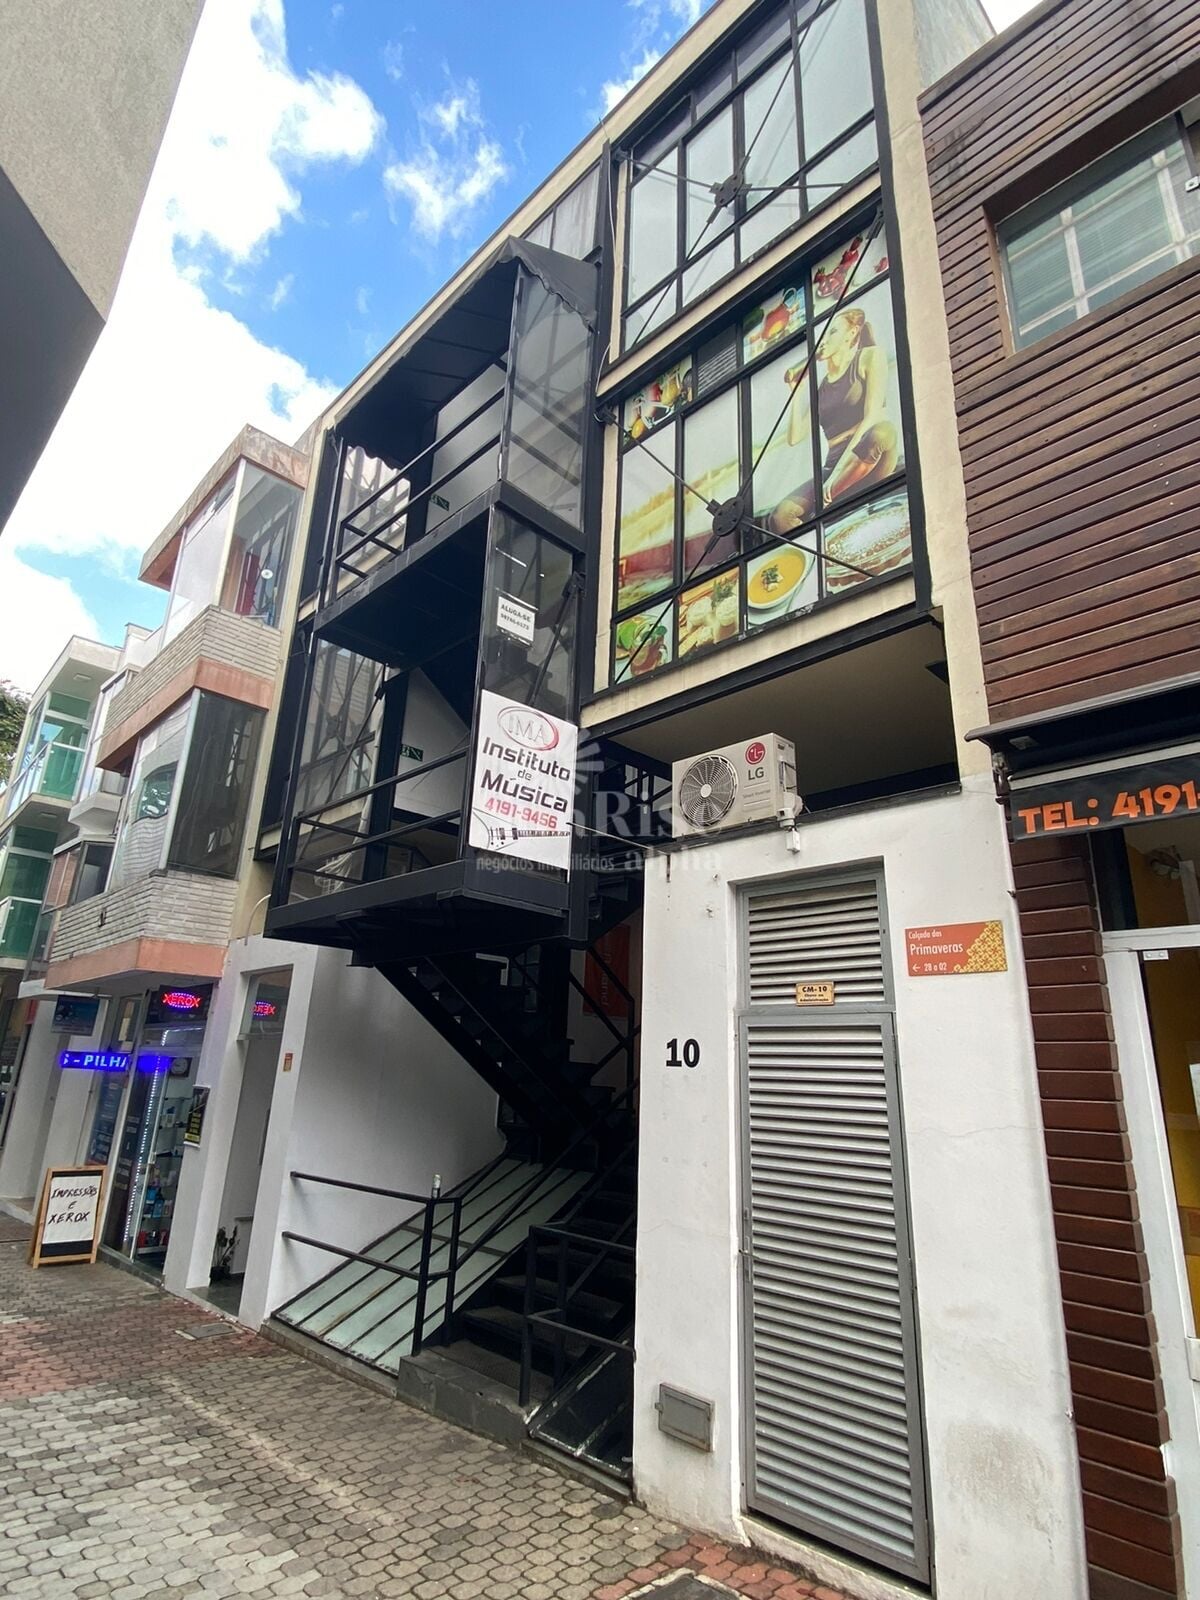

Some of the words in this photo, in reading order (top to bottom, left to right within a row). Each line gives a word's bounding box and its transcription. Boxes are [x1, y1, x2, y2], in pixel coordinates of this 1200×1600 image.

[501, 604, 532, 622] ALUGA-SE
[508, 715, 548, 745] IMA
[482, 737, 570, 781] Instituto
[517, 769, 532, 781] de
[748, 767, 765, 781] LG
[481, 769, 568, 812] Música
[485, 797, 558, 829] 4191-9456
[1018, 798, 1099, 833] TEL:
[1112, 780, 1200, 818] 4191
[908, 931, 931, 941] Calçada
[931, 929, 942, 938] das
[910, 943, 963, 956] Primaveras
[924, 963, 932, 972] 28
[938, 962, 947, 971] 02
[162, 993, 201, 1008] XEROX
[666, 1038, 700, 1068] 10
[48, 1211, 90, 1225] XEROX
